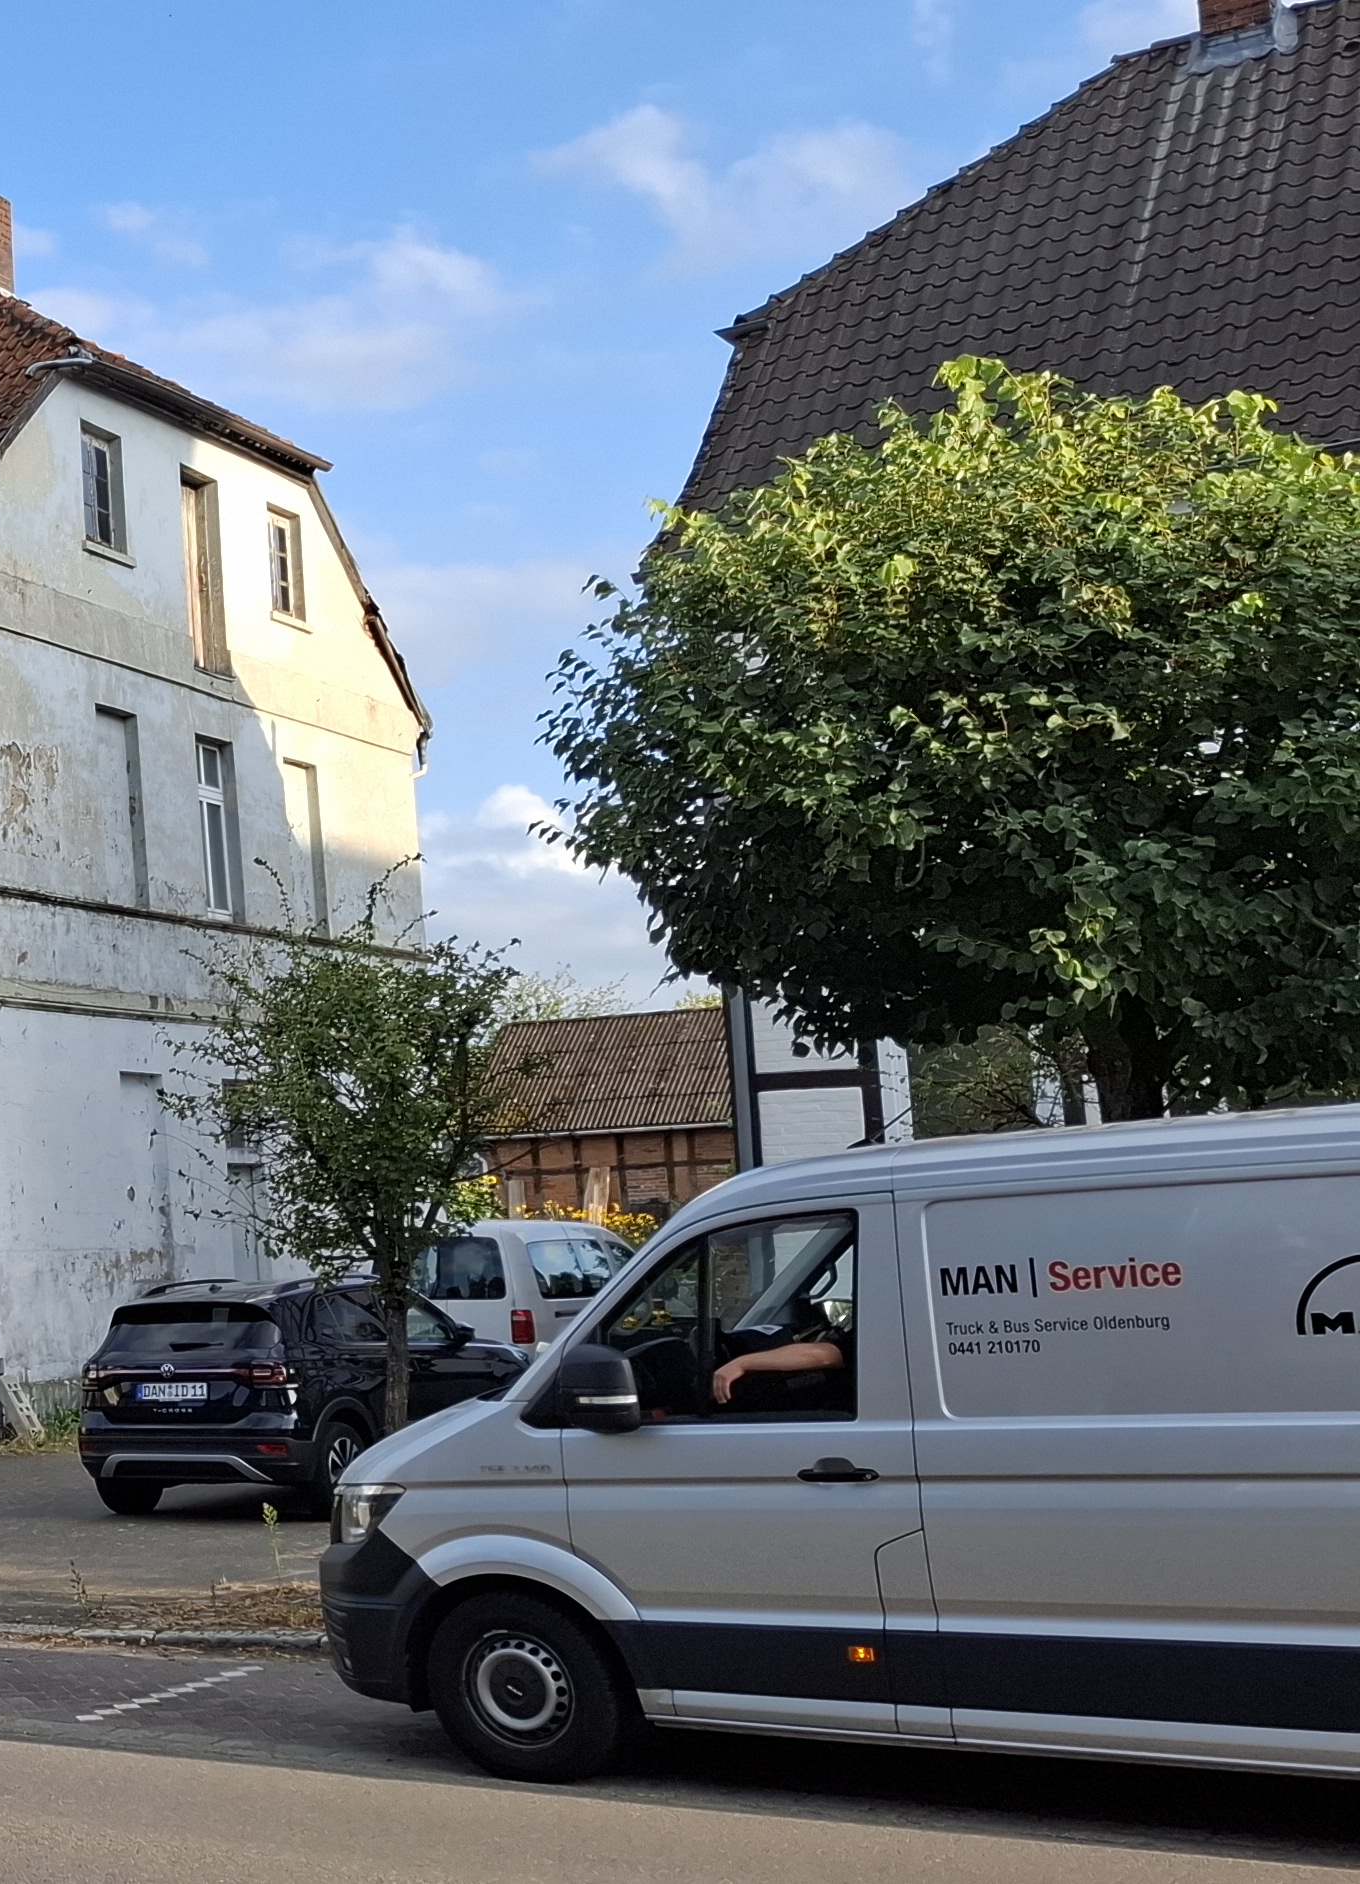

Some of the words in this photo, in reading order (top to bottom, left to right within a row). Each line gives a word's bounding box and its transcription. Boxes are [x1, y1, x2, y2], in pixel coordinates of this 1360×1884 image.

[940, 1264, 1018, 1296] MAN
[1048, 1257, 1182, 1292] Service
[945, 1321, 984, 1335] Truck
[989, 1320, 999, 1334] &
[1003, 1320, 1029, 1333] Bus
[1034, 1318, 1088, 1332] Service
[1093, 1315, 1170, 1331] Oldenburg
[948, 1341, 981, 1355] 0441
[987, 1339, 1041, 1354] 210170
[143, 1385, 166, 1397] DAN
